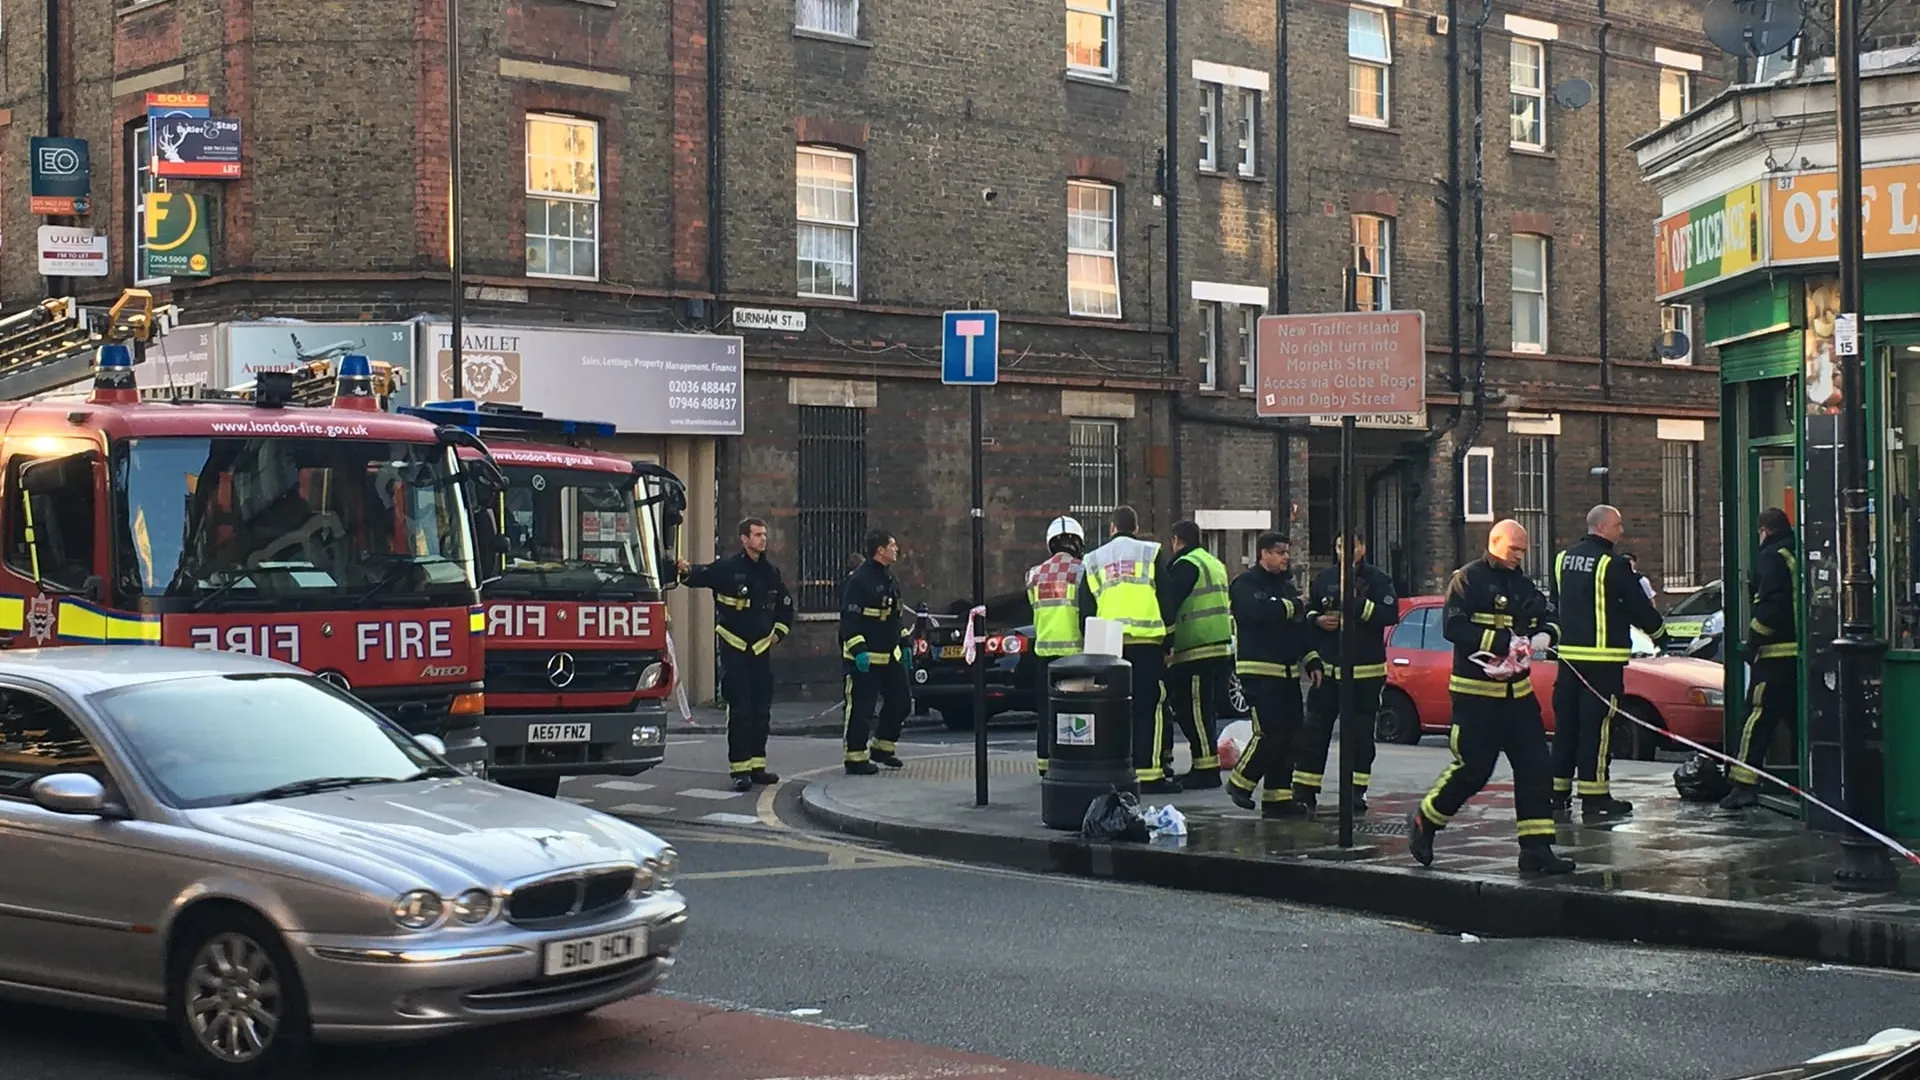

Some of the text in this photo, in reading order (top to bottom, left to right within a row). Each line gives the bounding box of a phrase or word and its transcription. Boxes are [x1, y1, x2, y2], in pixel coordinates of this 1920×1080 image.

[157, 94, 197, 103] SOLD
[217, 121, 238, 131] Stag
[223, 165, 240, 173] LET
[1780, 177, 1792, 189] 37
[1672, 201, 1747, 274] OFF LICENCE
[736, 311, 778, 325] BURNHAM
[1278, 320, 1400, 337] New Traffic Island
[392, 332, 403, 342] 35
[438, 333, 521, 351] TAMLET
[727, 345, 736, 355] 35
[1280, 339, 1398, 357] No right turn into
[1840, 341, 1853, 353] 15
[634, 358, 664, 370] Property
[711, 363, 737, 373] Finance
[1287, 357, 1390, 373] Morpeth Street
[669, 380, 737, 394] 02036 488447
[1263, 373, 1417, 390] Access via Globe Road
[669, 396, 737, 410] 07946 488437
[1280, 392, 1396, 408] and Digby Street
[211, 420, 369, 438] www.london-fire.gov.uk
[1563, 555, 1595, 573] FIRE
[578, 606, 651, 637] FIRE
[356, 620, 453, 661] FIRE
[532, 724, 586, 741] AE57 FNZ
